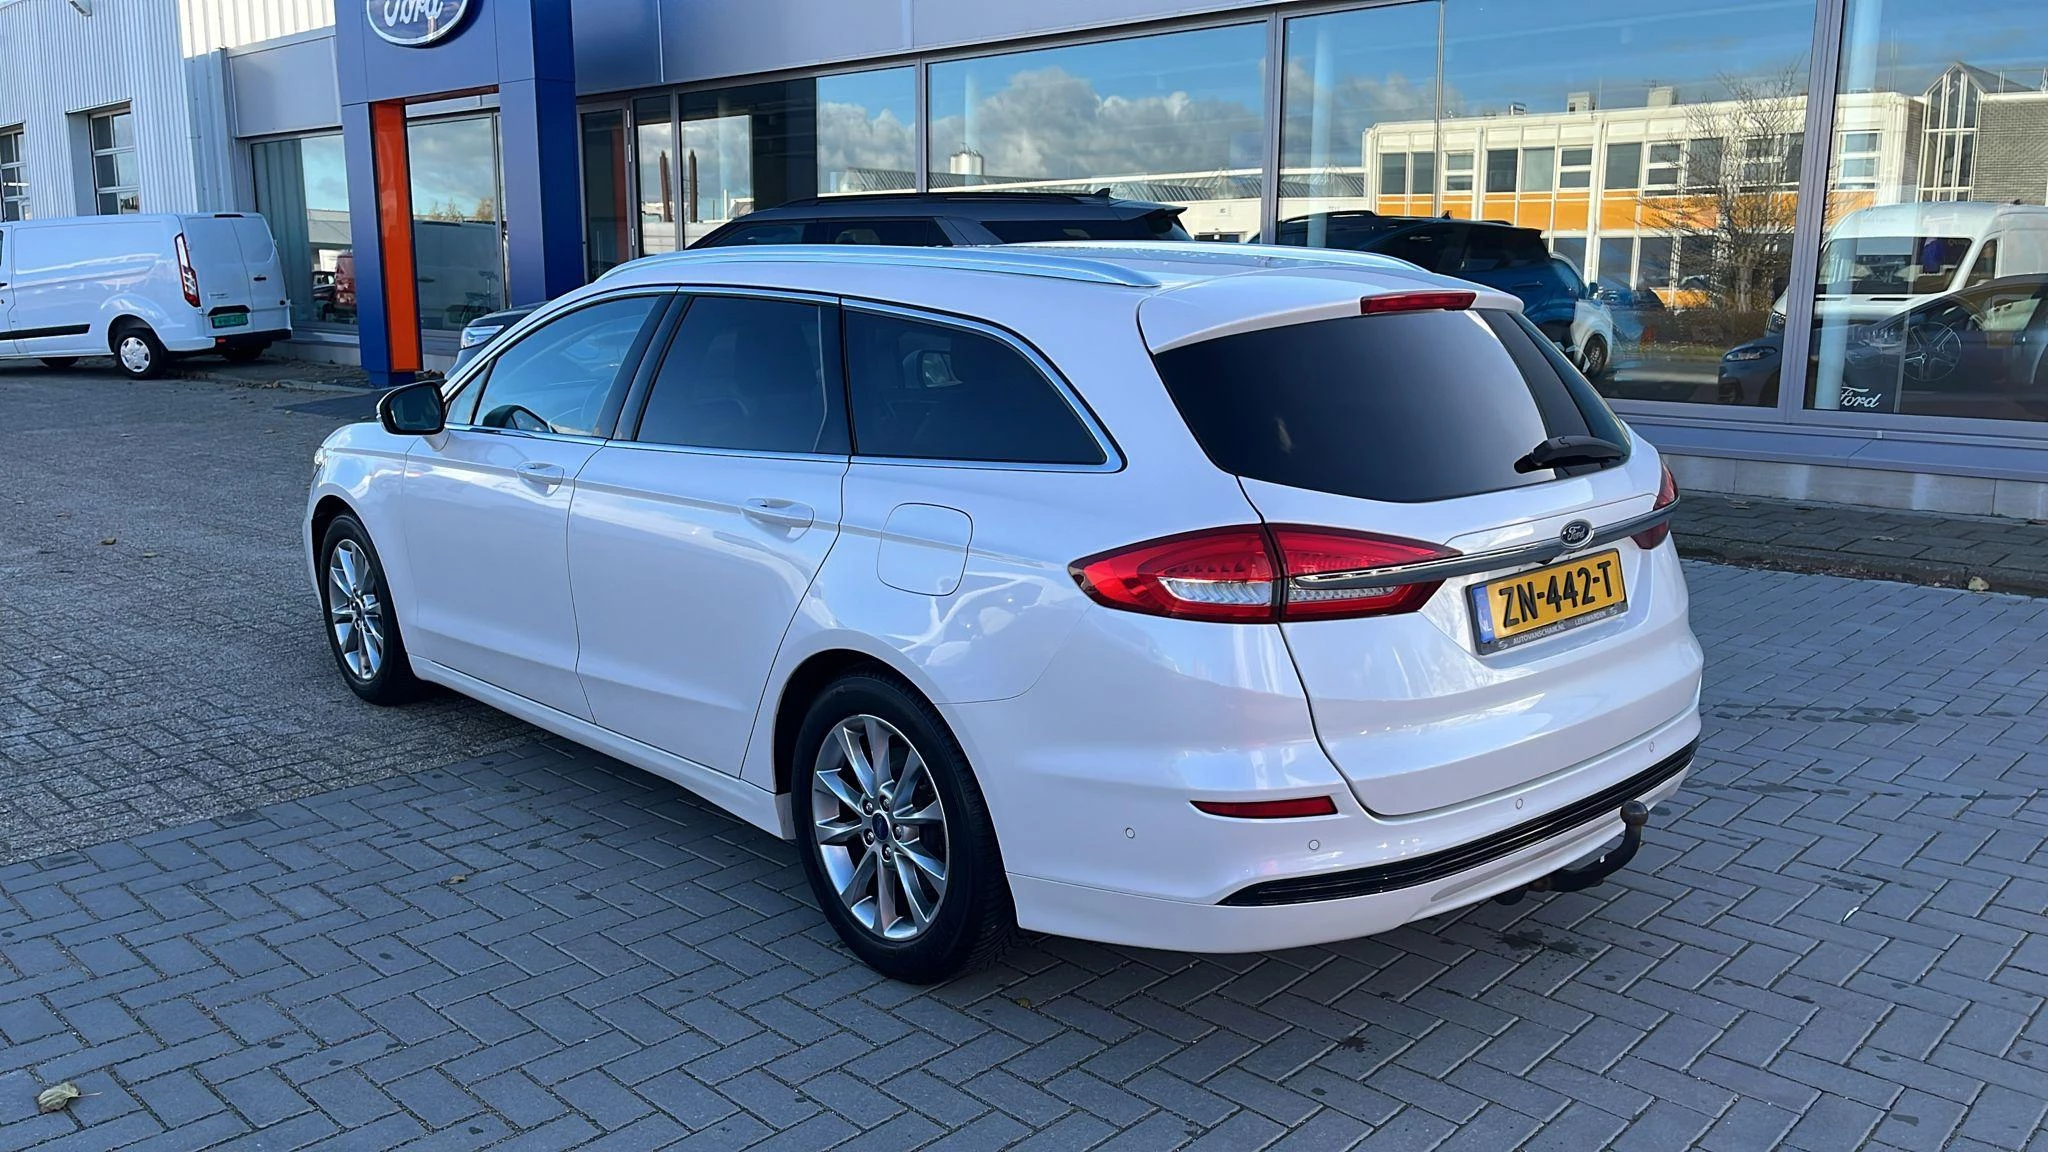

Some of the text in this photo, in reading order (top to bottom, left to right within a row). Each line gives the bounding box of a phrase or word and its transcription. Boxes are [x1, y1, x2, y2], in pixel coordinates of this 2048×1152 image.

[1840, 386, 1882, 408] Ford
[1567, 525, 1586, 541] Ford
[1499, 560, 1612, 628] ZN-442-T
[1480, 618, 1492, 633] NL
